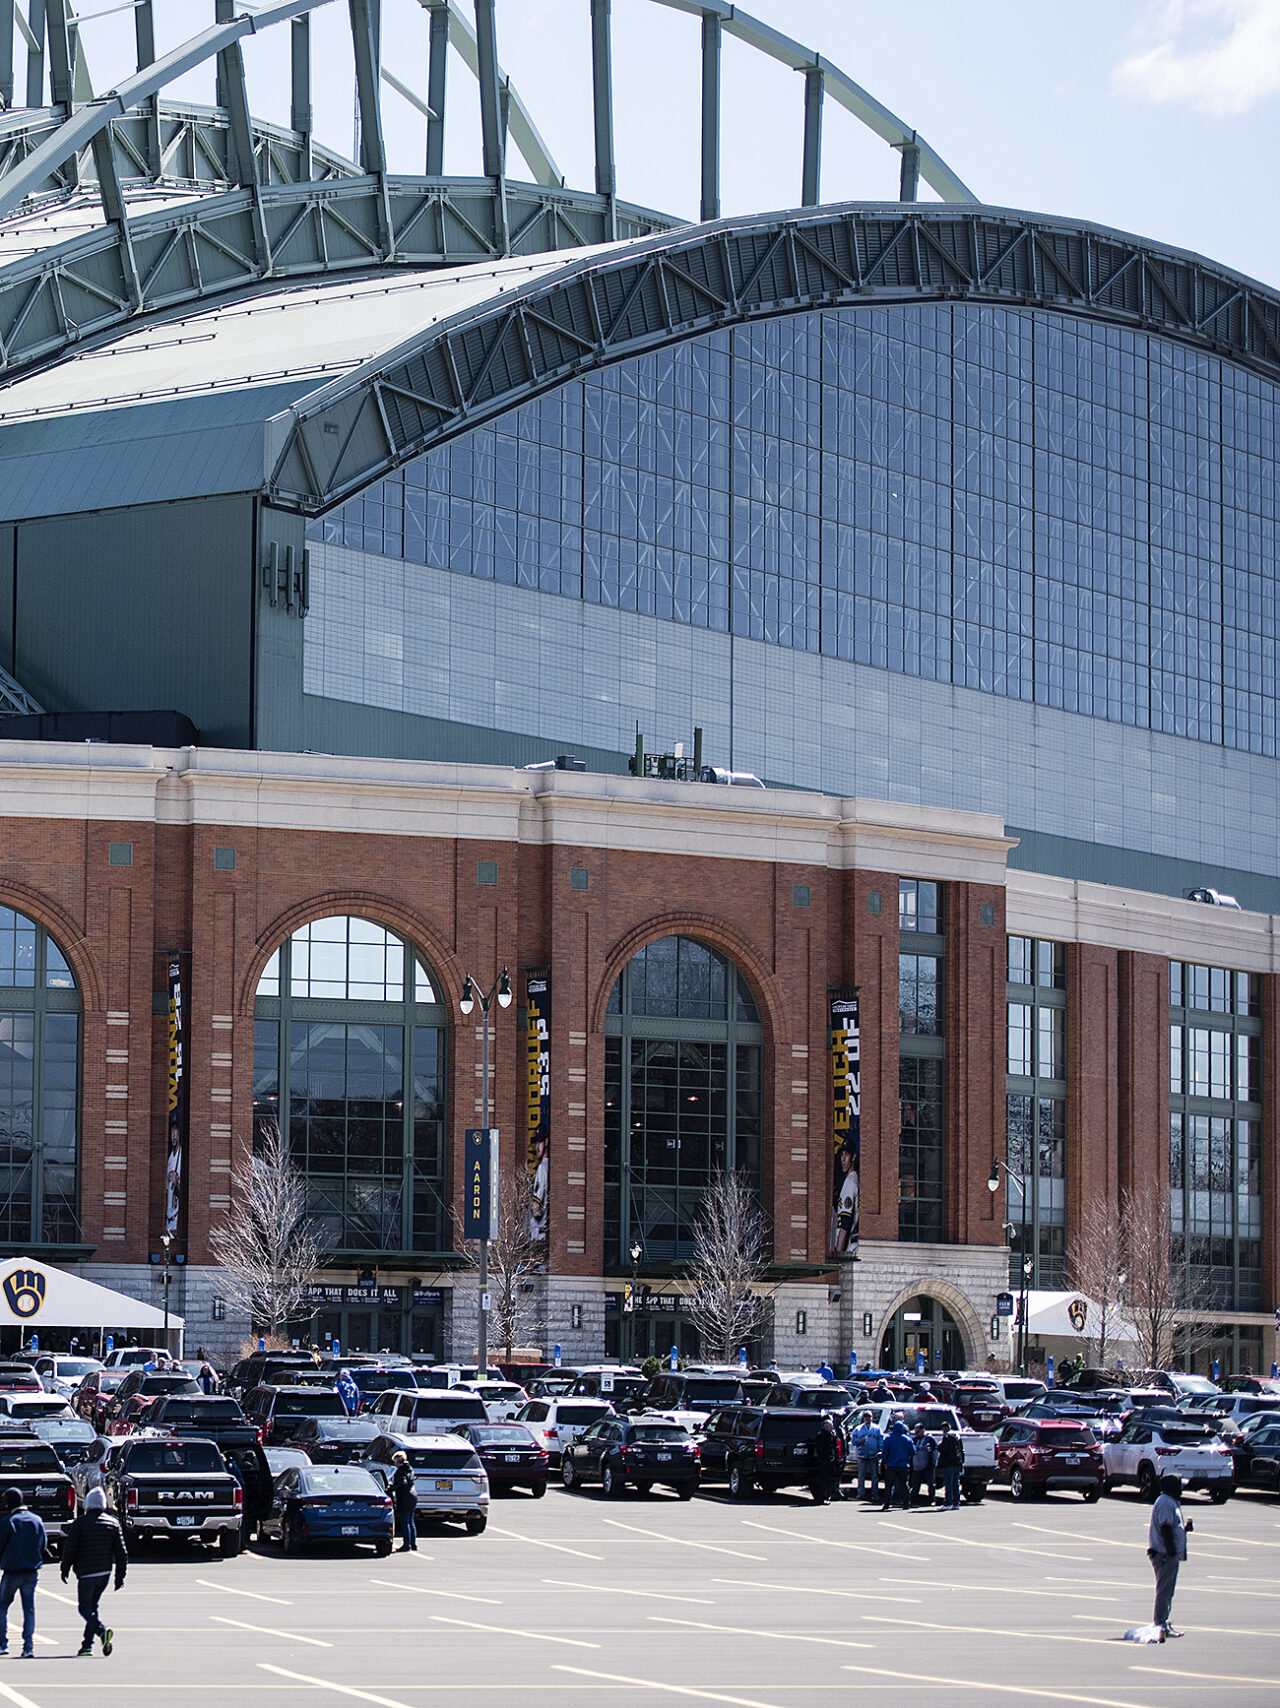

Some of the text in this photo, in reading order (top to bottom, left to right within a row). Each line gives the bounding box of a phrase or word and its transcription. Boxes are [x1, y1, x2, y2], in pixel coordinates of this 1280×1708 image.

[842, 1017, 860, 1063] OF
[537, 1050, 550, 1096] 53
[844, 1071, 861, 1117] 22
[472, 1160, 481, 1220] AARON
[307, 1287, 323, 1296] APP
[324, 1287, 343, 1297] THAT
[347, 1288, 368, 1297] DOES
[370, 1288, 379, 1297] IT
[383, 1289, 397, 1298] ALL
[659, 1296, 675, 1305] THAT
[157, 1491, 215, 1500] RAM
